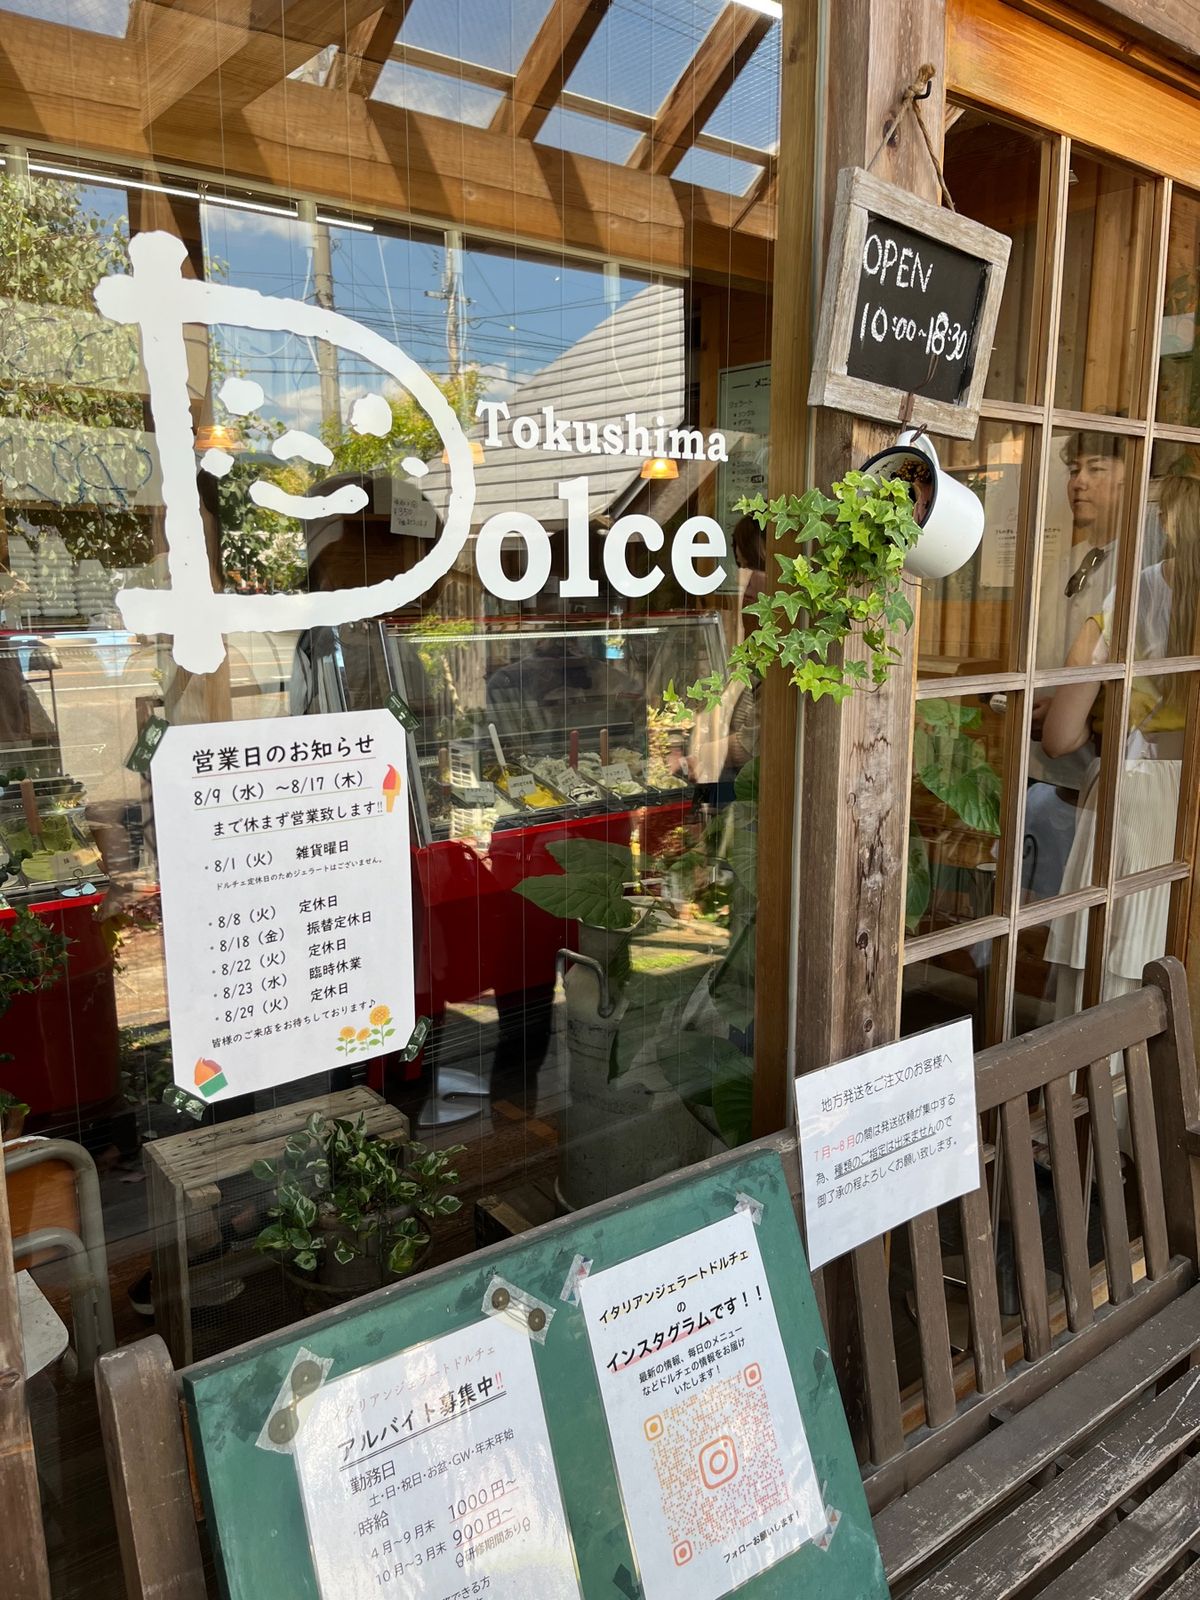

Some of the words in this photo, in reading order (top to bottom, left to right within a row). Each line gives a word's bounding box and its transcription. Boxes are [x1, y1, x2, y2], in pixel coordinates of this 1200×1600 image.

[863, 235, 933, 292] OPEN
[475, 400, 728, 462] Tokushima
[192, 734, 375, 774] 営業日のお知らせ
[295, 840, 349, 860] 雑貨曜日
[216, 858, 382, 890] ドルチェ定休日のためジェラートはございません。
[299, 895, 338, 914] 定休日
[306, 911, 372, 935] 振替定休日
[308, 938, 347, 957] 定休日
[309, 956, 362, 980] 臨時休業
[310, 982, 349, 1002] 定休日
[821, 1053, 952, 1112] 地方発送をご注文のお客様へ
[599, 1250, 749, 1324] イタリアンジェラートドルチェ
[676, 1301, 686, 1313] の
[642, 1337, 745, 1396] などドルチェの情報をお届け
[350, 1460, 396, 1495] 勤務日
[357, 1510, 390, 1537] 時給
